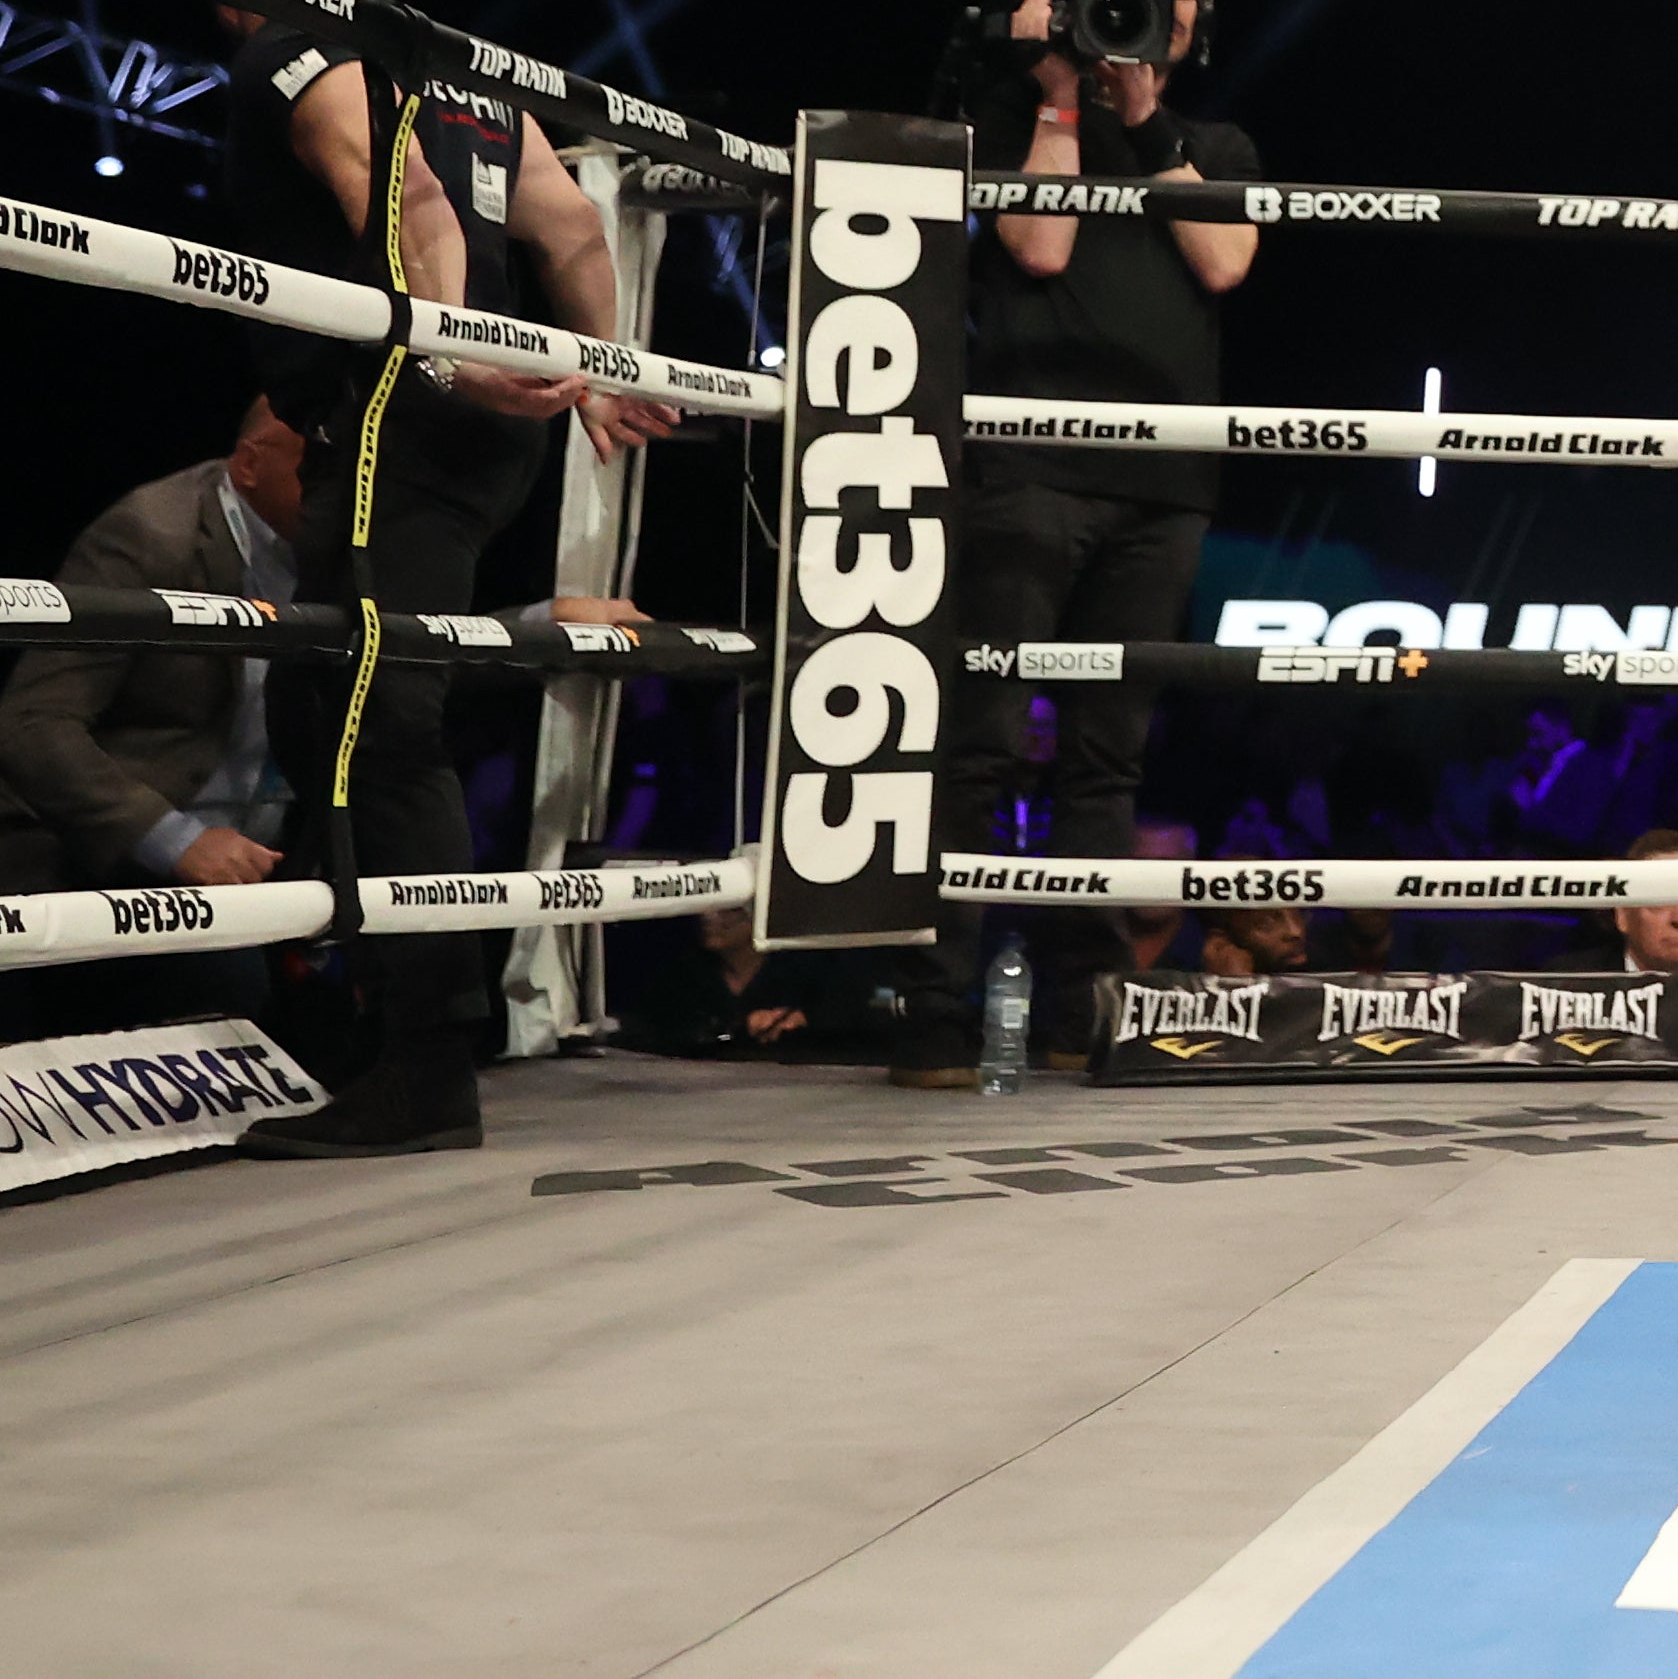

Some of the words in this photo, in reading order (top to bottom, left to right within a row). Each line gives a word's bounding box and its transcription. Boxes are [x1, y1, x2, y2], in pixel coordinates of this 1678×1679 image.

[468, 37, 512, 80] TOP
[512, 54, 567, 99] RANK
[625, 97, 688, 141] BOXXER
[715, 128, 750, 163] TOP
[750, 143, 792, 176] RANK
[970, 183, 1028, 212] OP
[1033, 184, 1151, 215] RANK
[1288, 190, 1442, 222] BOXXER
[1538, 197, 1622, 227] TOP
[13, 203, 90, 255] Clark
[167, 235, 270, 306] bet365
[438, 310, 502, 346] Arnold
[504, 321, 549, 356] Clark
[573, 331, 641, 383] bet365
[668, 364, 715, 393] Arnold
[717, 373, 752, 399] Clark
[963, 417, 1057, 437] rnold
[1062, 419, 1158, 440] Clark
[1228, 417, 1368, 451] bet365
[1438, 427, 1562, 454] Arnold
[1569, 433, 1665, 458] Clark
[781, 159, 966, 884] bet365
[964, 643, 1016, 677] sky
[1024, 648, 1116, 676] sports
[1563, 652, 1616, 682] sky
[389, 879, 457, 906] Arnold
[460, 879, 509, 905] Clark
[532, 873, 604, 910] bet365
[632, 873, 683, 900] Arnold
[1013, 869, 1113, 894] Clark
[1182, 867, 1325, 903] bet365
[1396, 875, 1525, 900] Arnold
[1531, 875, 1630, 899] Clark
[97, 889, 215, 935] bet365
[1115, 982, 1270, 1043] EVERLAST
[1317, 982, 1468, 1042] EVERLAST
[1517, 981, 1664, 1043] EVERLAST
